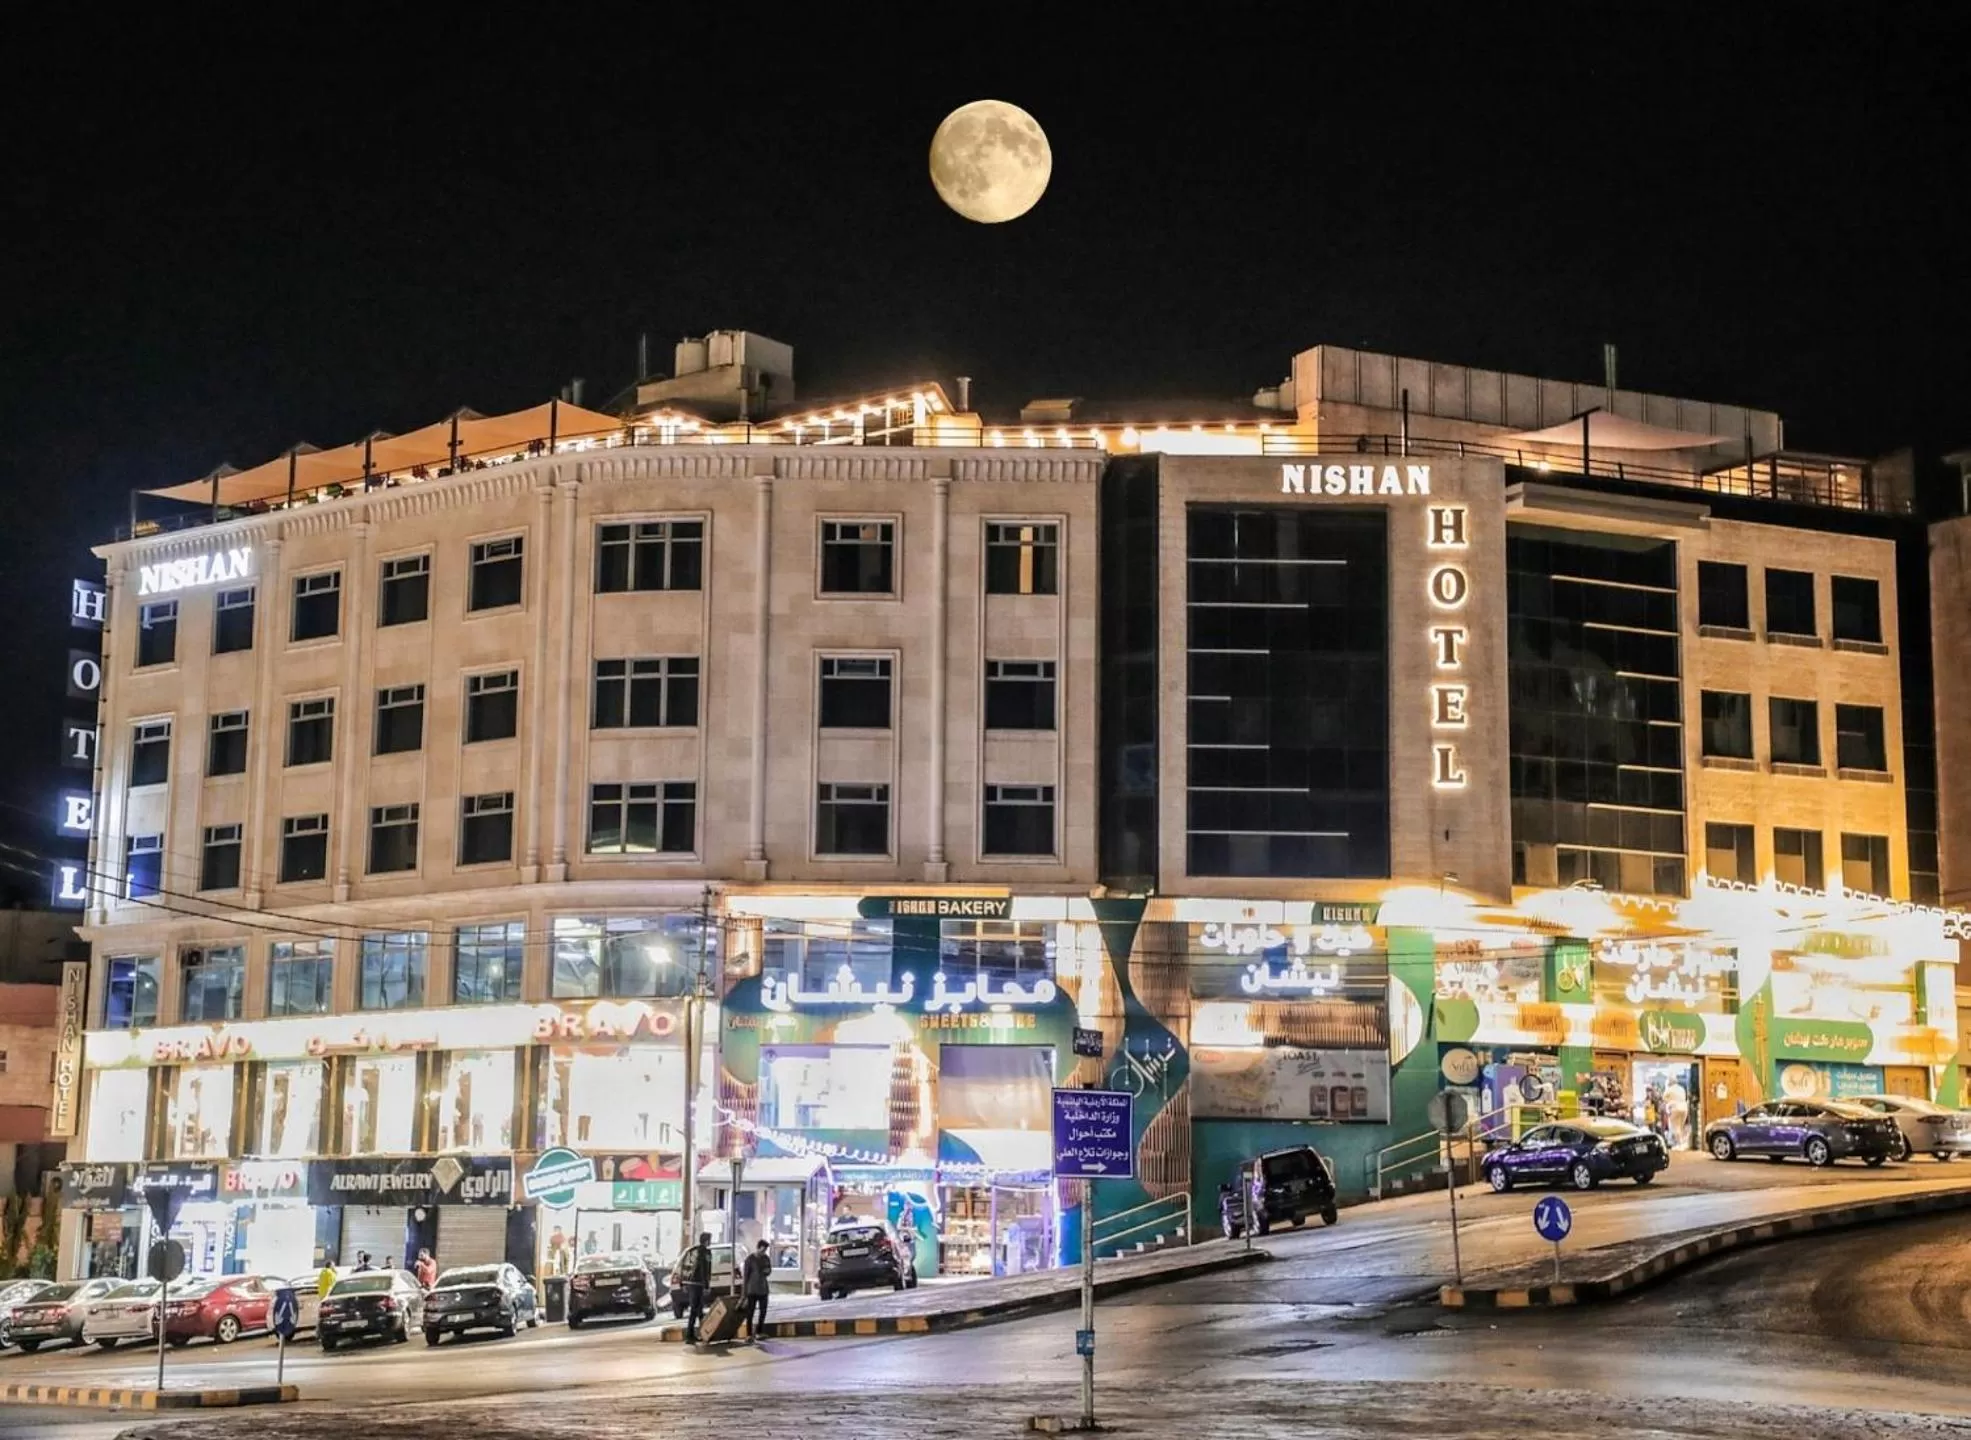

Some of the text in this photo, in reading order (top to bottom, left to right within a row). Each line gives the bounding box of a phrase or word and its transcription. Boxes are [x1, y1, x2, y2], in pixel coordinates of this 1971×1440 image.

[1282, 464, 1430, 495] NISHAN
[139, 547, 252, 596] NISHAN
[1428, 505, 1468, 786] HOTEL
[60, 586, 105, 899] HOTEL
[938, 900, 1006, 915] BAKERY
[761, 963, 915, 1012] نيشان
[1241, 957, 1340, 997] نيشان
[533, 1010, 677, 1040] BRAVO
[56, 968, 80, 1130] NISHAN HOTEL
[155, 1034, 253, 1060] BRAVO
[1064, 1110, 1120, 1124] وزارة الداخلية
[1094, 1128, 1117, 1141] مكتب
[1096, 1148, 1129, 1161] وجوازات
[330, 1173, 433, 1193] ALRAWI JEWELRY
[460, 1169, 511, 1204] الراوي
